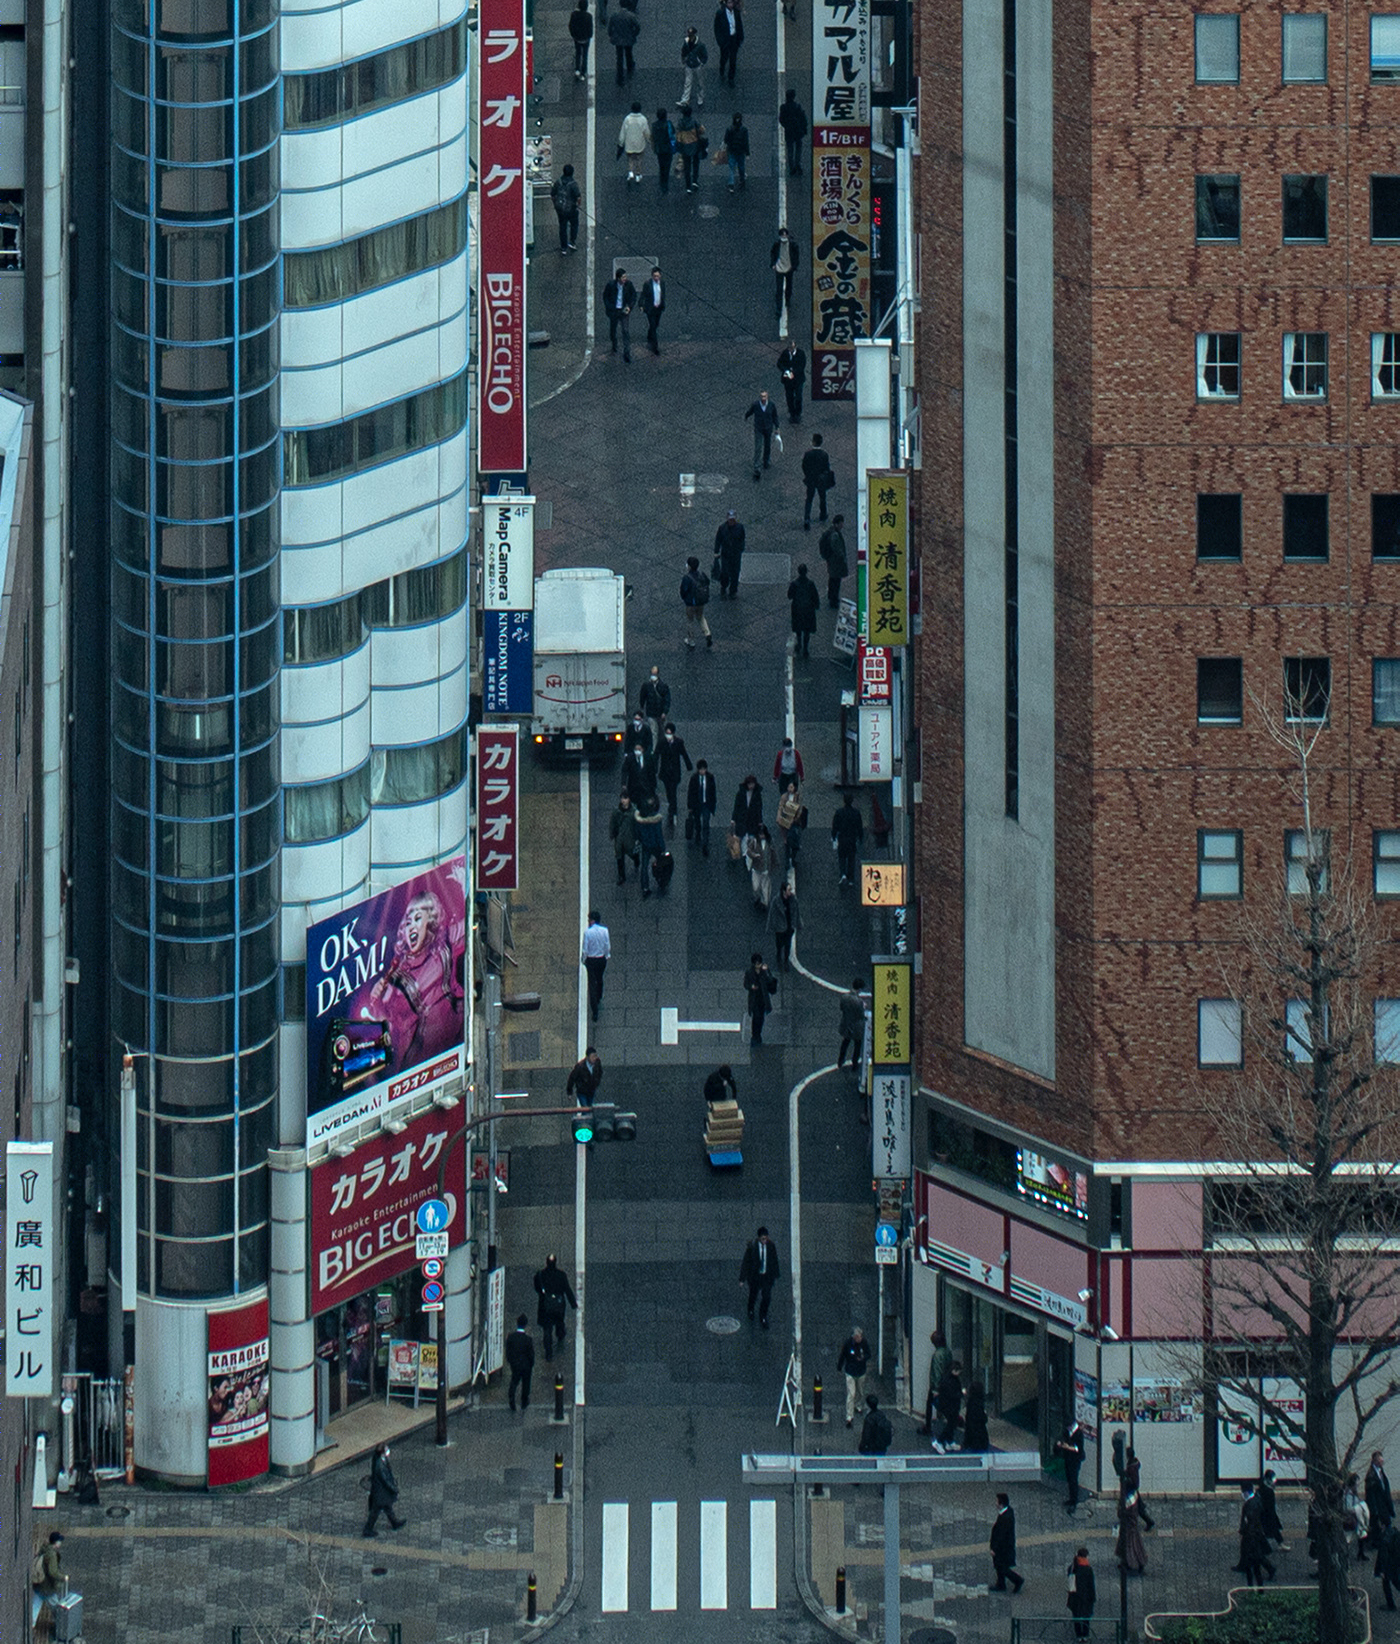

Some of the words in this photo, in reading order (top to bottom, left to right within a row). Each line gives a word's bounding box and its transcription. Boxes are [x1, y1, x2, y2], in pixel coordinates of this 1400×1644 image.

[820, 129, 865, 145] 1F/B1F
[820, 155, 842, 200] 酒場
[846, 155, 863, 225] きんくら
[486, 272, 513, 326] BIG
[514, 286, 522, 322] Karaoke
[816, 230, 869, 345] 金の蔵
[488, 333, 513, 414] ECHO
[514, 328, 522, 399] Entertainment
[495, 507, 511, 540] Map
[514, 507, 529, 517] 4F
[877, 487, 899, 529] 焼肉
[498, 542, 511, 601] Camera
[874, 541, 904, 634] 清香苑
[499, 612, 508, 670] KINGDOM
[514, 613, 529, 623] 2F
[865, 647, 884, 656] PC
[499, 673, 508, 706] NOTE
[870, 712, 881, 774] ユーアイ薬局
[482, 743, 512, 877] カラオケ
[865, 866, 882, 903] ねぎし
[320, 917, 368, 973] OK,
[316, 935, 388, 1018] DAM!
[885, 969, 899, 995] 焼肉
[883, 1002, 902, 1059] 清香苑
[392, 1070, 430, 1098] カラオケ
[329, 1131, 448, 1216] カラオケ
[331, 1215, 370, 1241] Karaoke
[373, 1183, 438, 1221] Entertainmen
[319, 1232, 373, 1291] BIG
[14, 1220, 43, 1379] 廣和ビル
[212, 1341, 266, 1368] KARAOKE
